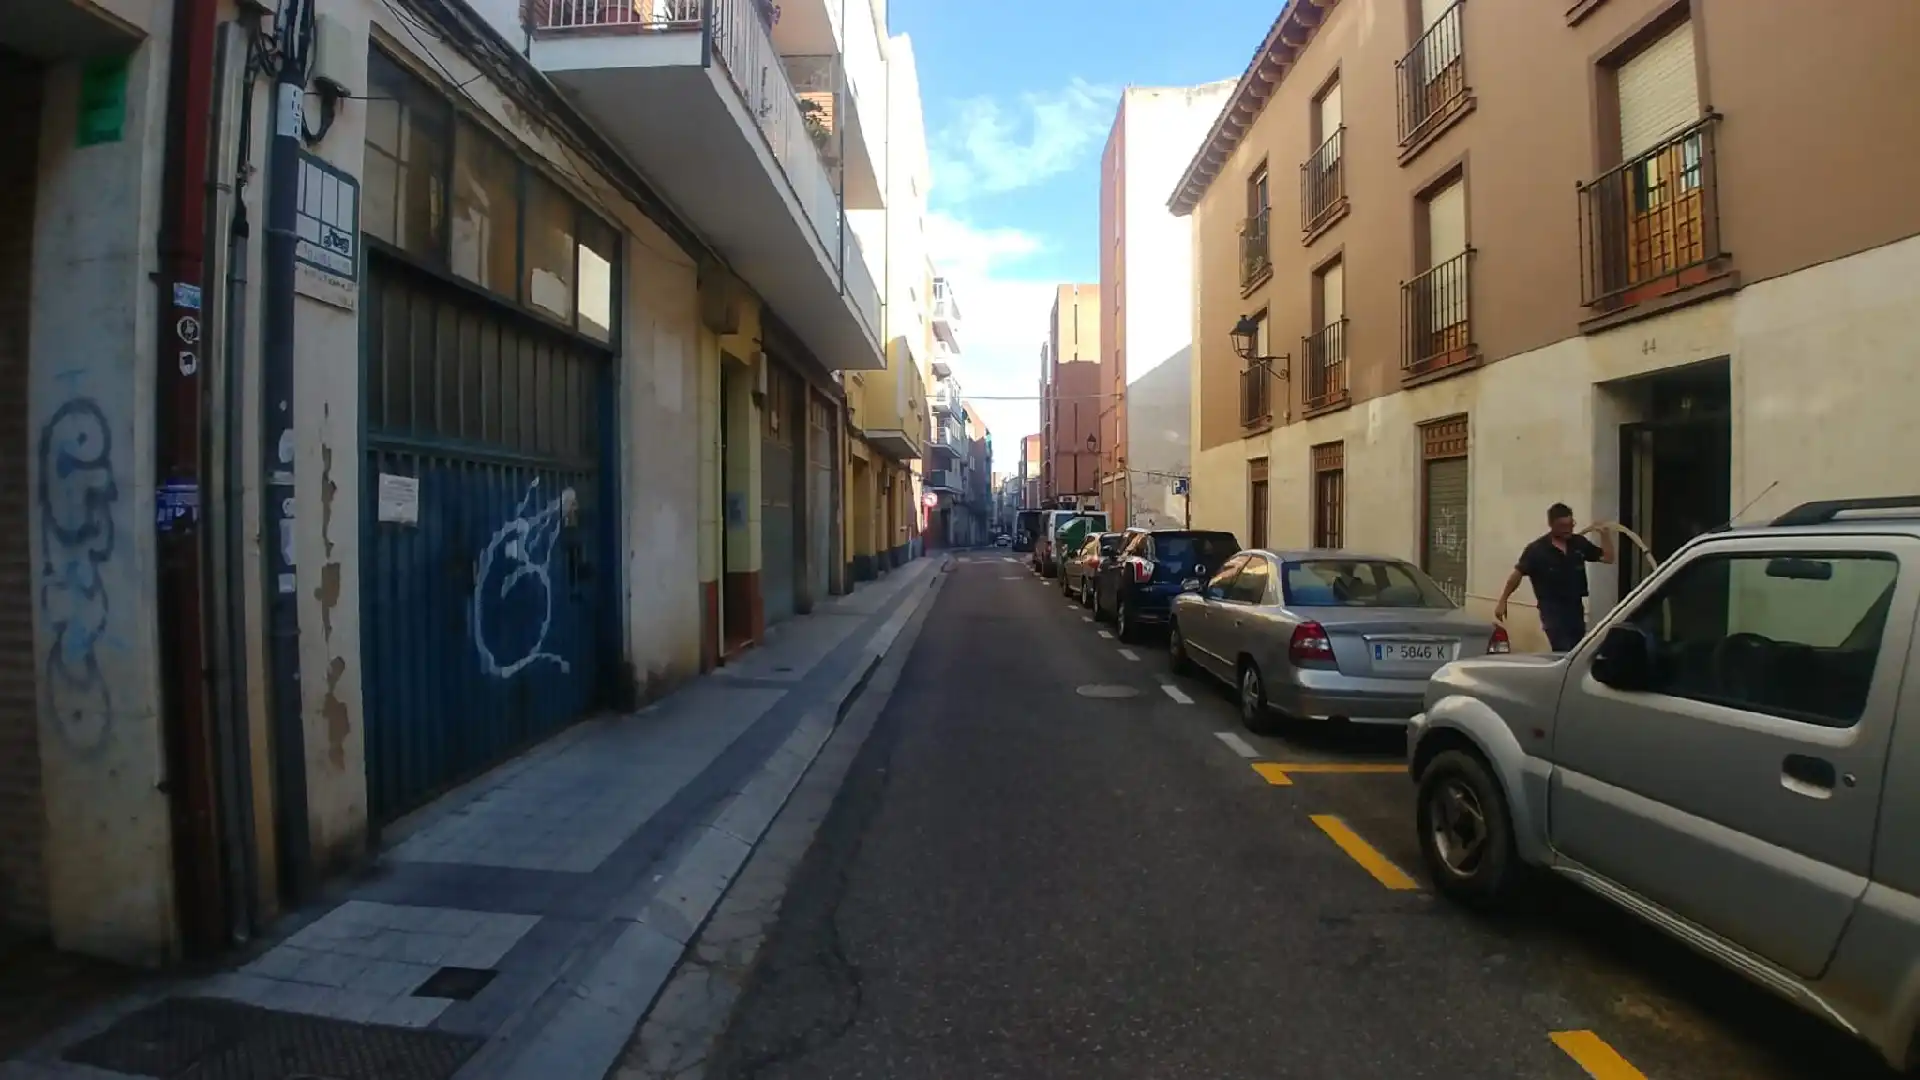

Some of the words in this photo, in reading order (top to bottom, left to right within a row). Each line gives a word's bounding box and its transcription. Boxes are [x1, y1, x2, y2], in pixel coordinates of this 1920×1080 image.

[1641, 337, 1657, 356] 44
[1386, 644, 1394, 659] P
[1400, 645, 1432, 659] 5846
[1436, 645, 1445, 659] K
